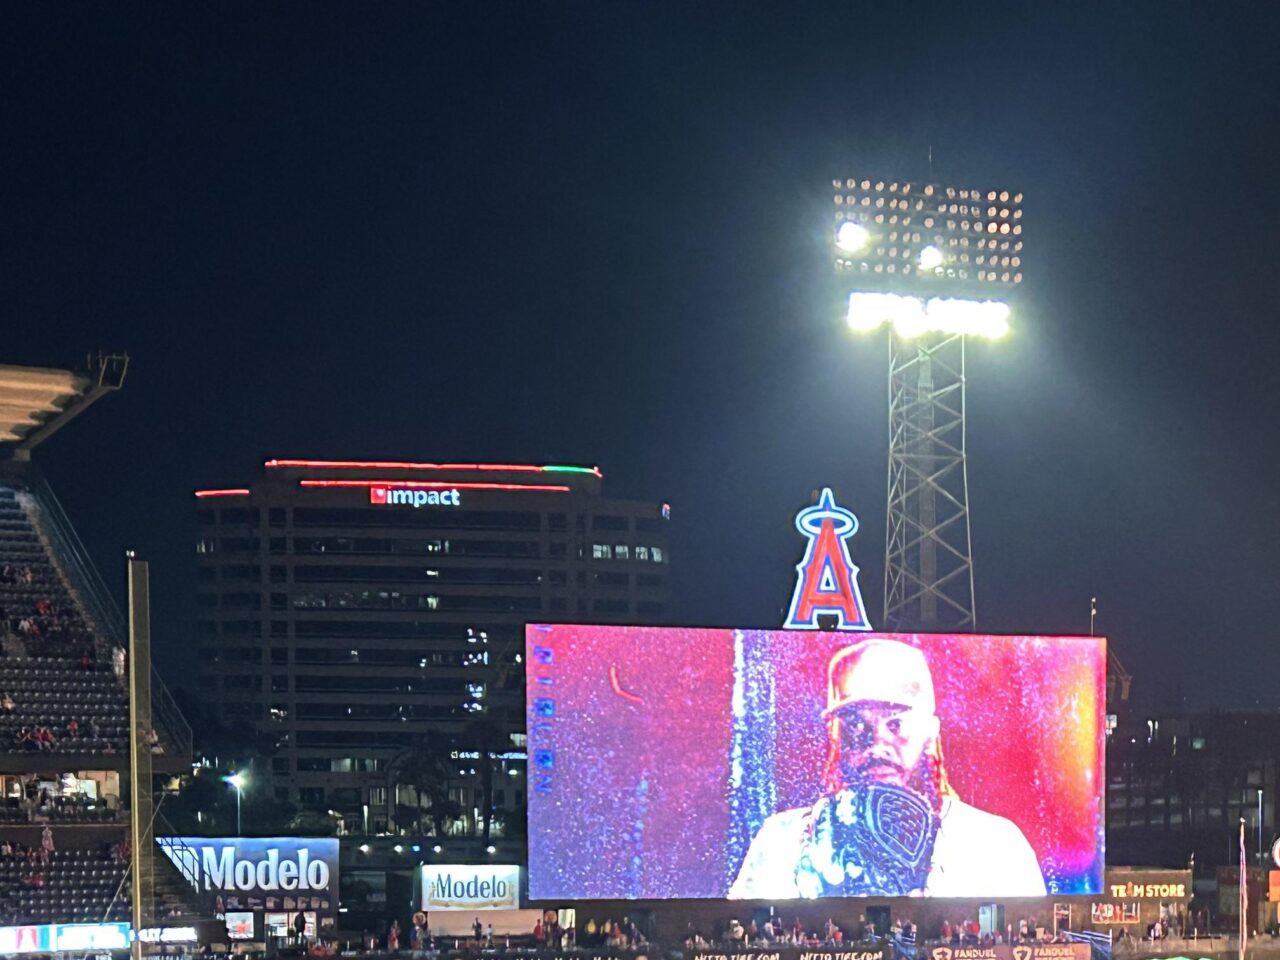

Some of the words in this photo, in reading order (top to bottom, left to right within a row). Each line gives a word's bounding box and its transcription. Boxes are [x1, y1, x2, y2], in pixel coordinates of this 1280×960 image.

[386, 488, 461, 508] impact
[201, 846, 330, 891] Modelo
[436, 873, 507, 898] Modelo
[1110, 881, 1144, 898] TEAM
[1146, 884, 1185, 898] STORE
[954, 949, 997, 958] FANDUEL
[1034, 947, 1076, 957] FANDUEL
